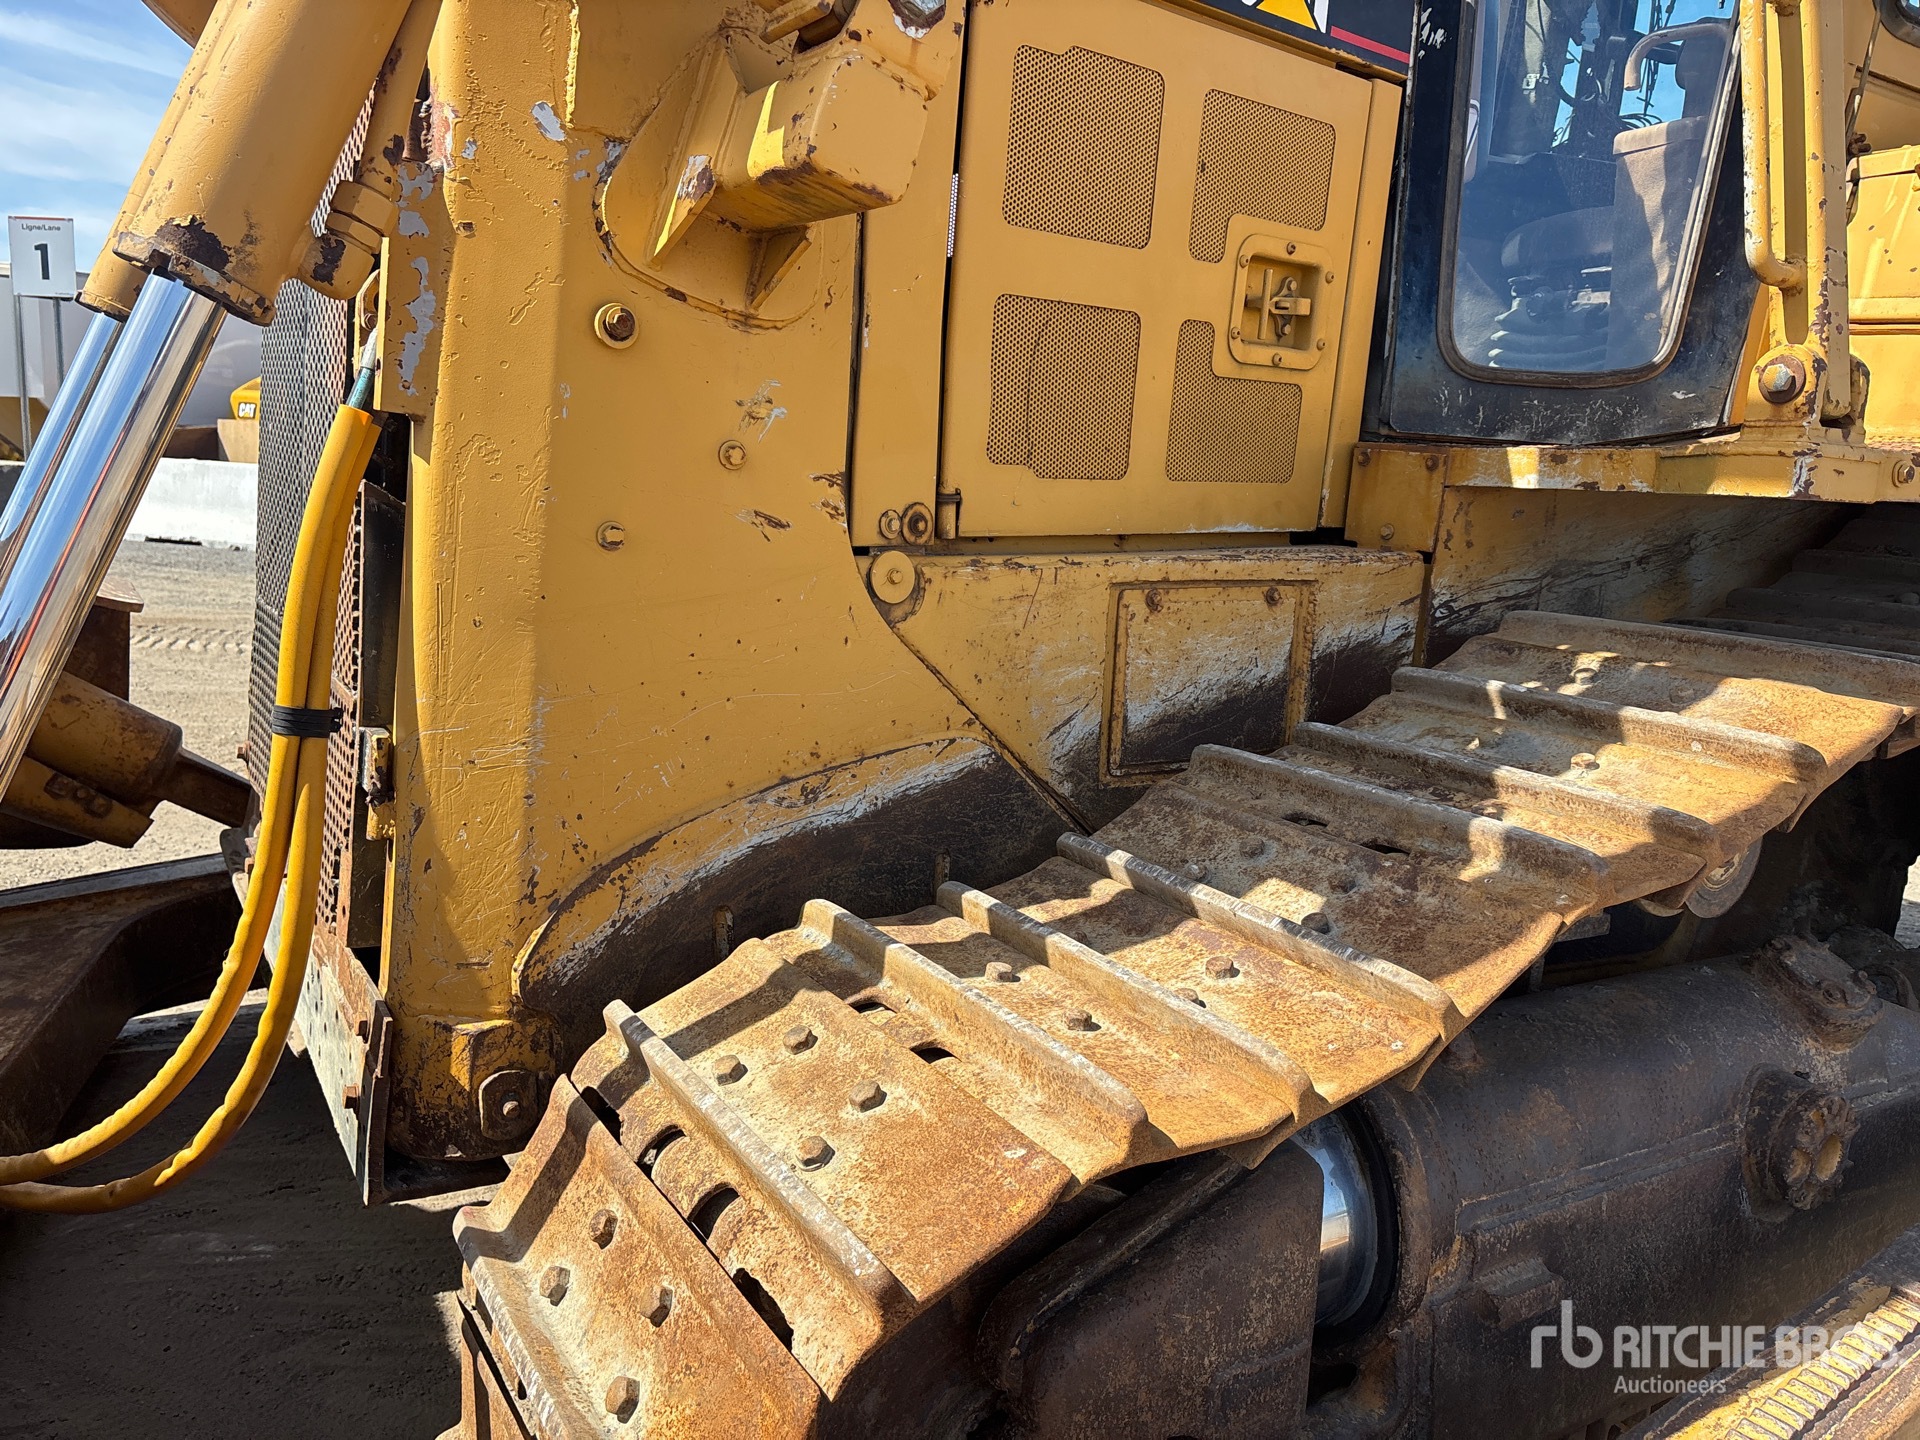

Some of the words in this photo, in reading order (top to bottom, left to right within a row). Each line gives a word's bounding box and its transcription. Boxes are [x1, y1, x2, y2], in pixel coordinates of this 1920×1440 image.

[21, 223, 61, 231] Ligne/Lane
[34, 243, 50, 280] 1
[238, 402, 257, 418] CAT
